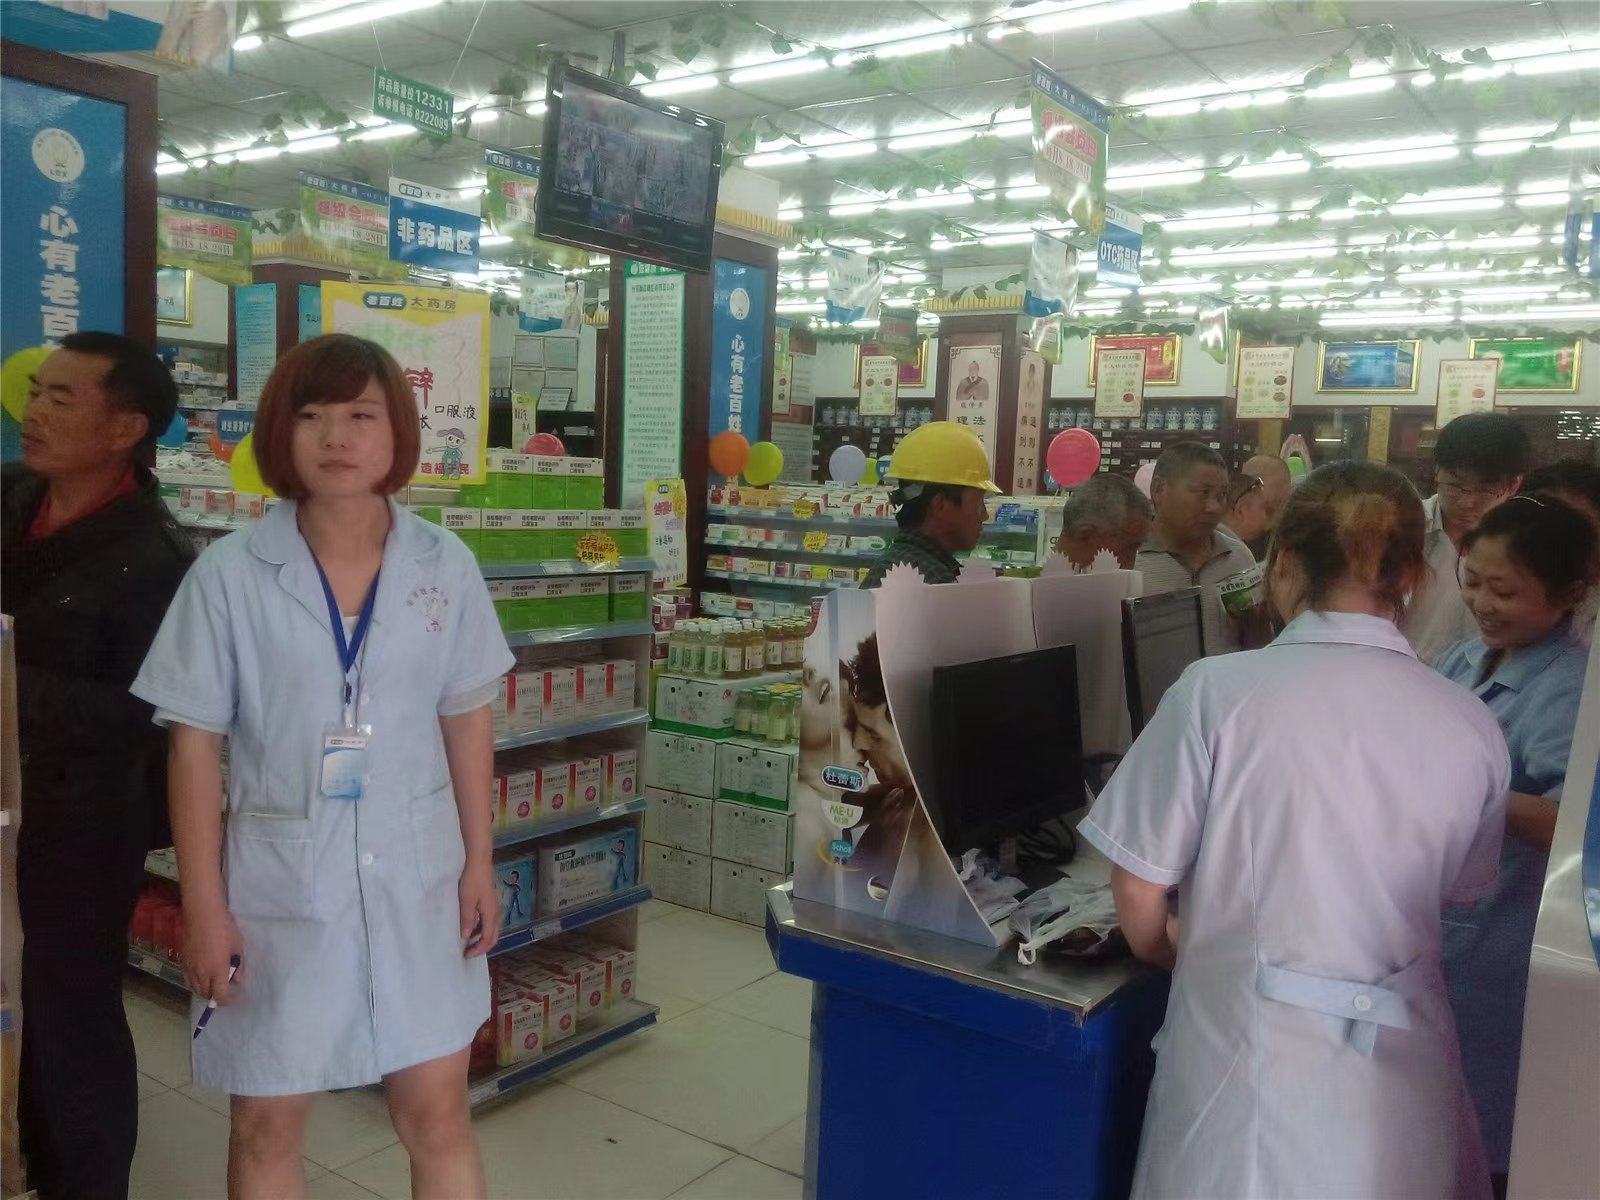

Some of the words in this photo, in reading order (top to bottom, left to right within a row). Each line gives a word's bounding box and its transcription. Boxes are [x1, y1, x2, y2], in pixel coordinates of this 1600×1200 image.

[415, 89, 450, 114] 12331
[397, 216, 474, 256] 非药品区
[366, 295, 404, 307] 老百姓
[411, 297, 457, 311] 大药房
[434, 404, 477, 420] 口服液
